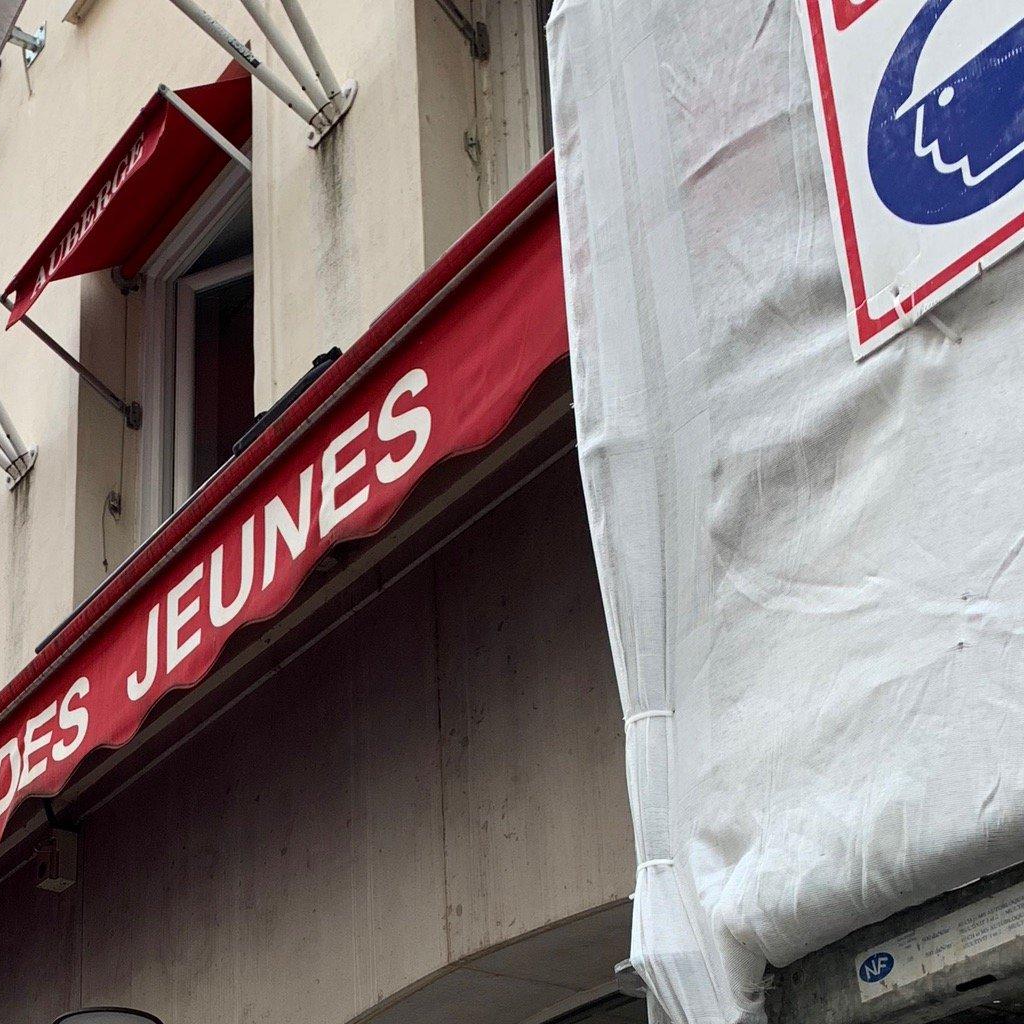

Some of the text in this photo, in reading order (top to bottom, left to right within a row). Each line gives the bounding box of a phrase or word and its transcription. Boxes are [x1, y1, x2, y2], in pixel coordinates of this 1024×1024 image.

[29, 132, 145, 300] AUBERGE
[127, 368, 432, 701] JEUNES
[864, 956, 890, 980] NF
